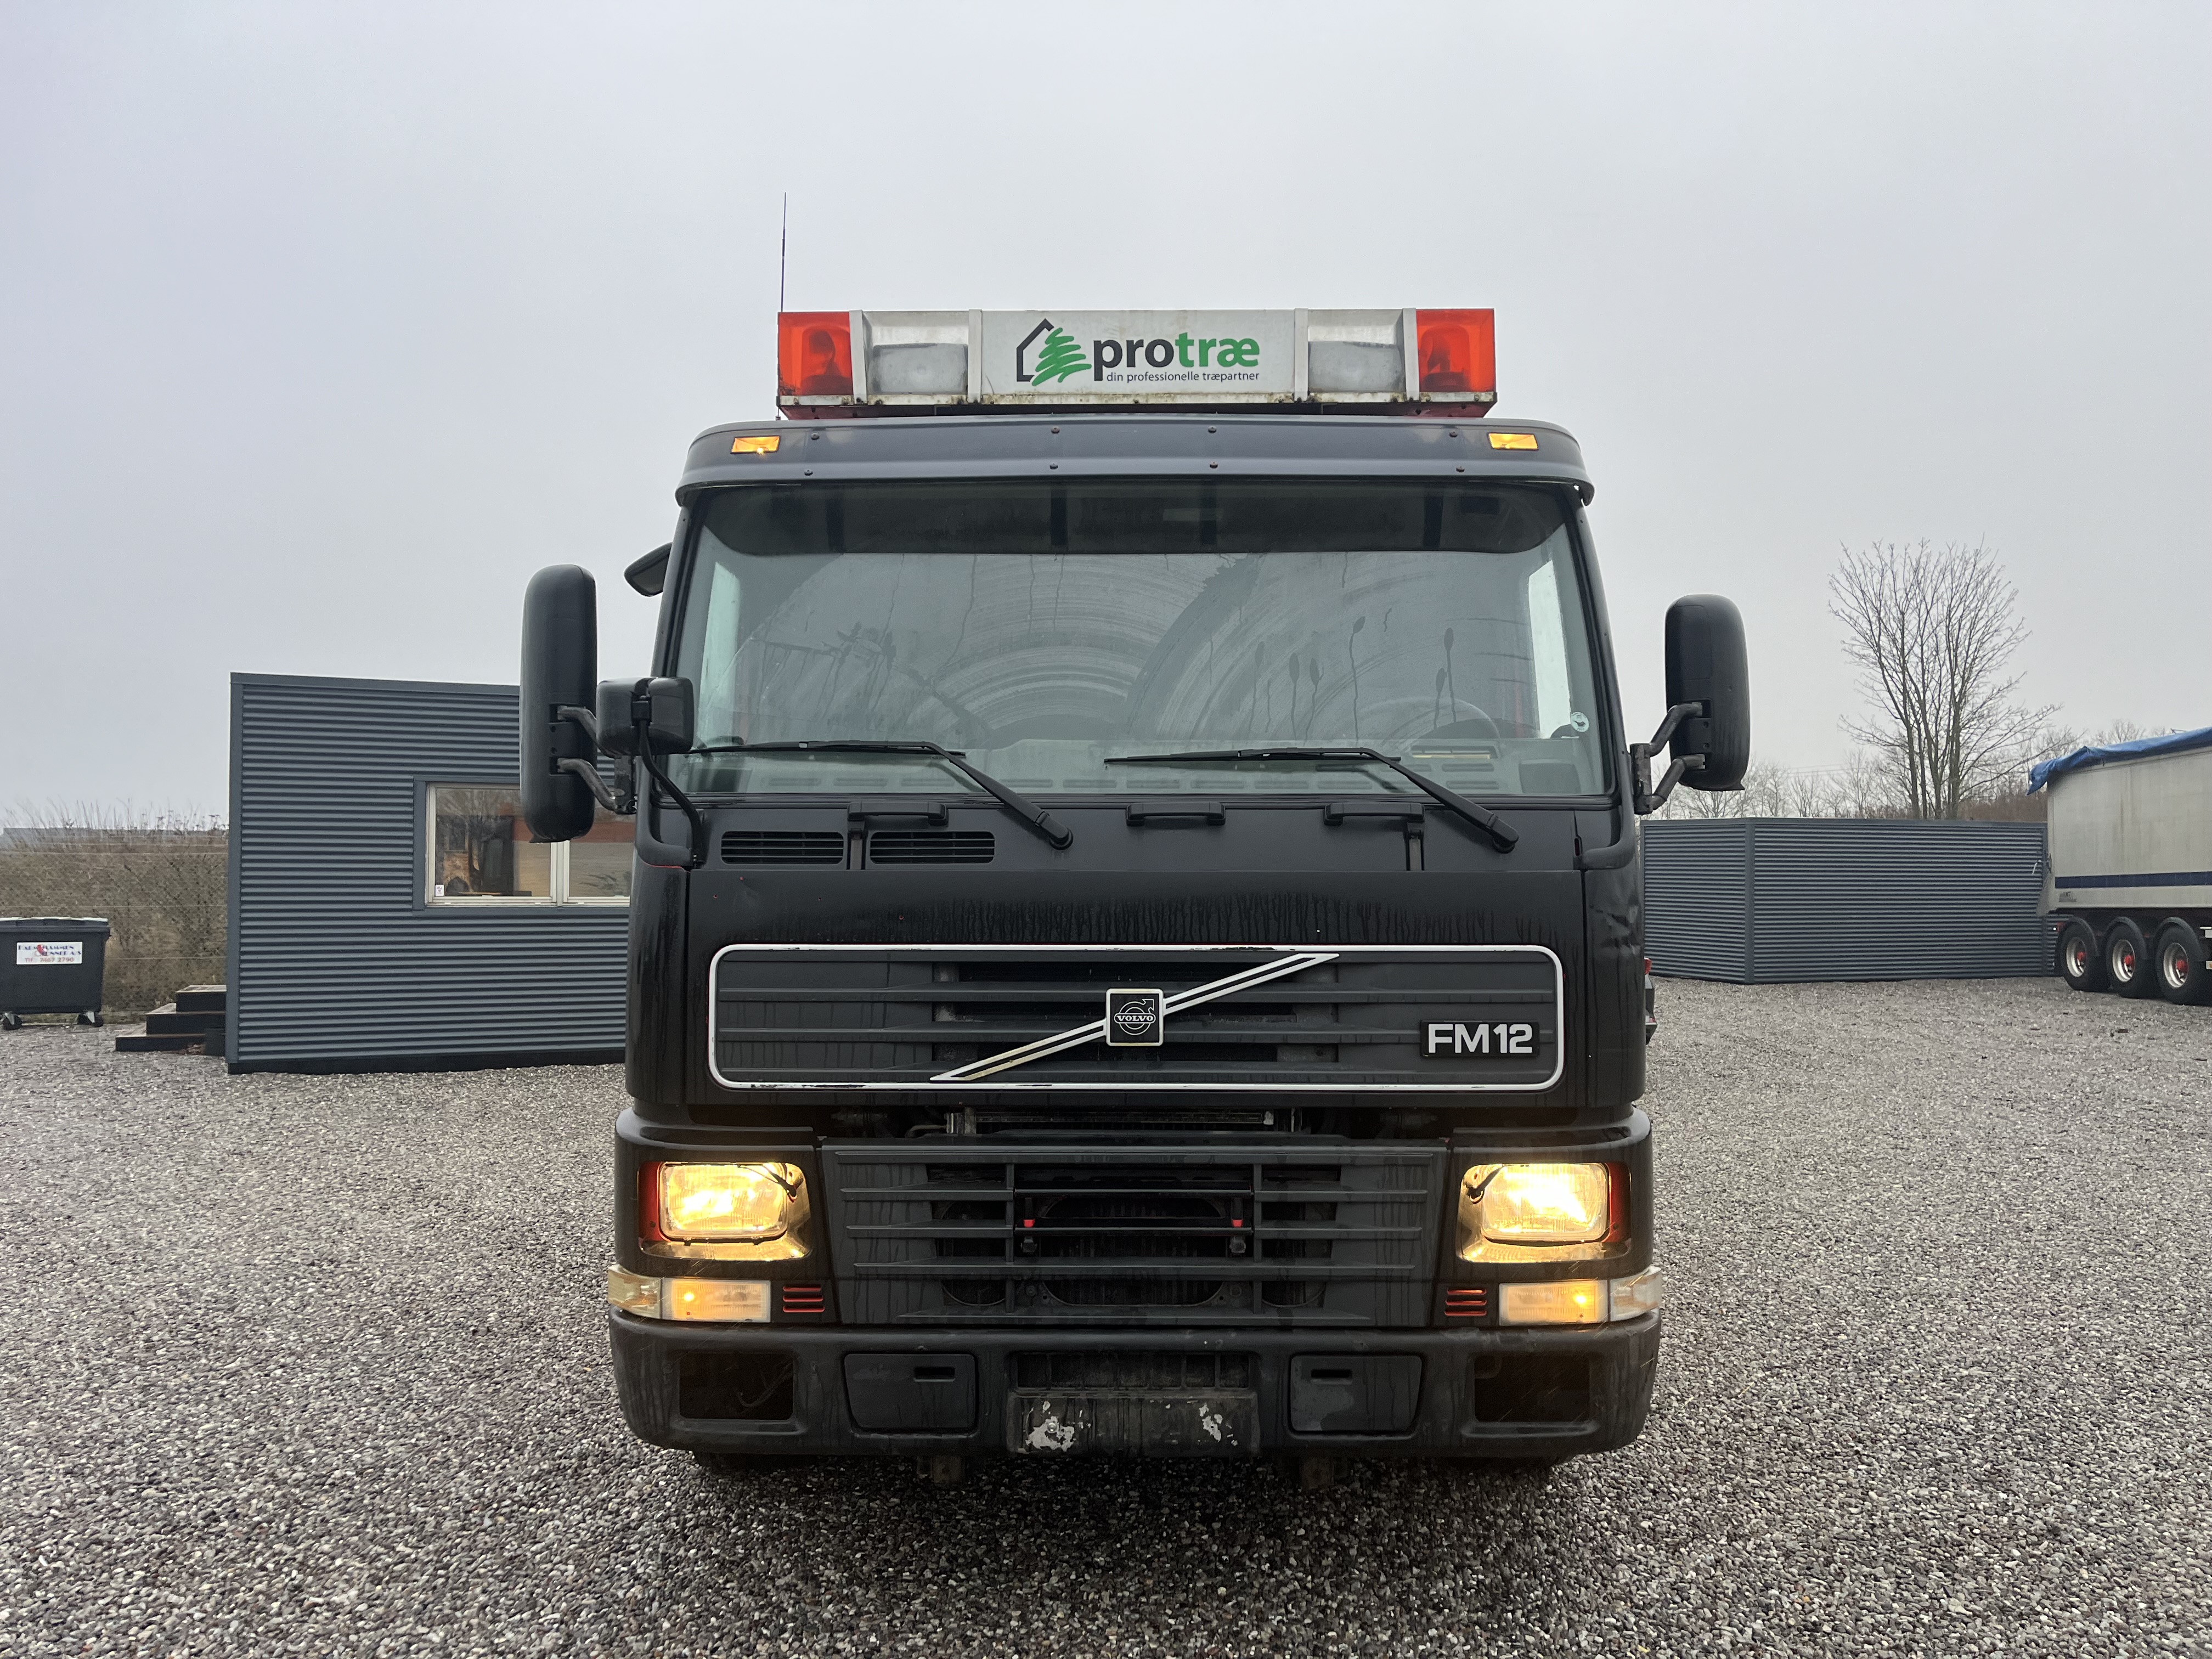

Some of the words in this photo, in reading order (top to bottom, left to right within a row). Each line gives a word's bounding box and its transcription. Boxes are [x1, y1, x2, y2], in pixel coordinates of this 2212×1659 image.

[1093, 332, 1260, 381] protræ
[1107, 372, 1124, 381] din
[1127, 371, 1199, 383] professionelle
[1202, 371, 1260, 382] træpartner
[1428, 1024, 1532, 1053] FM12
